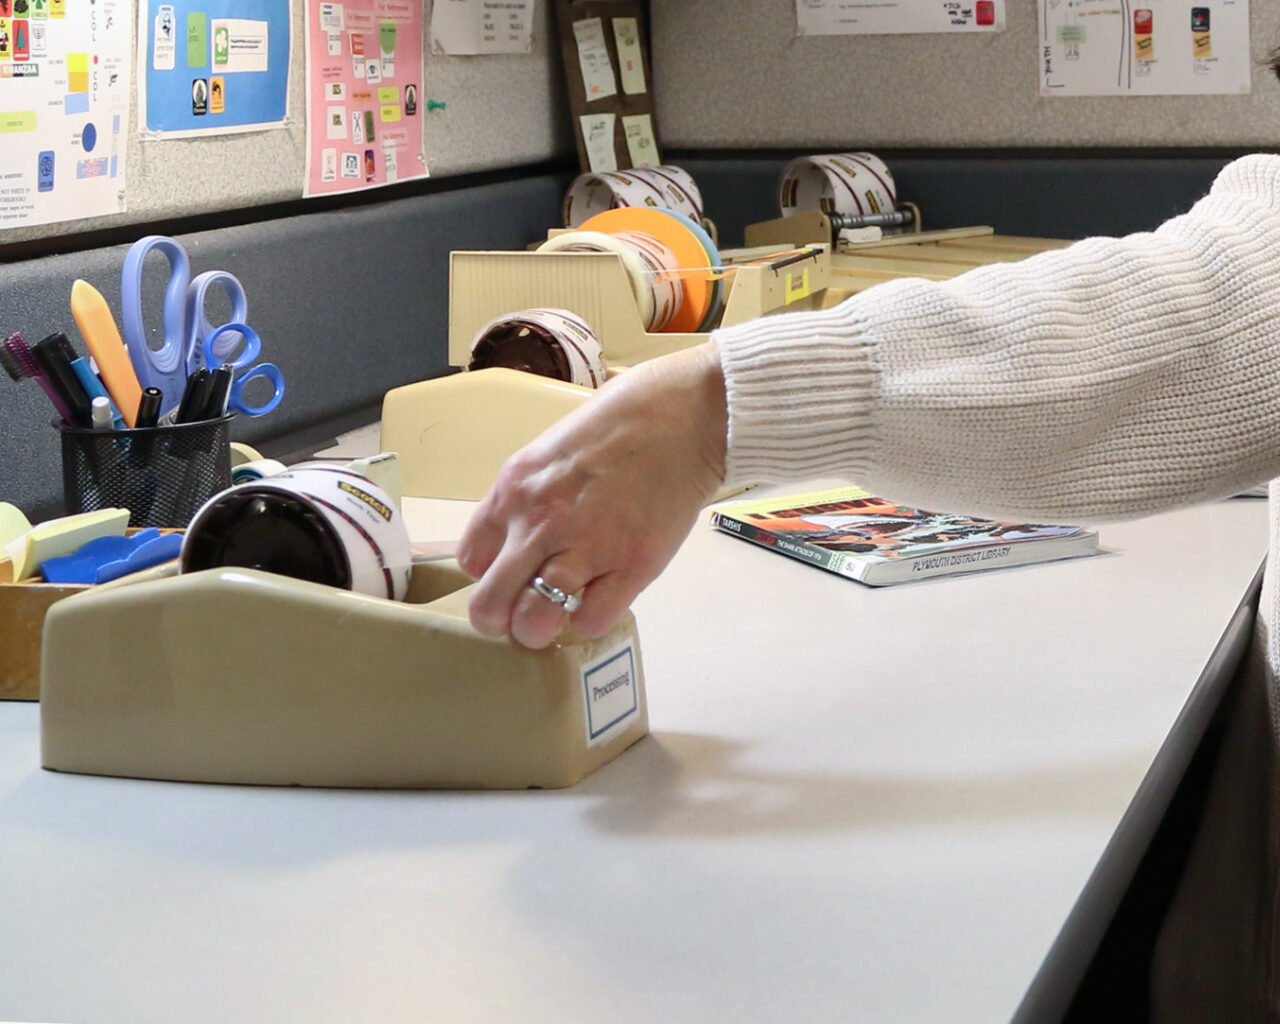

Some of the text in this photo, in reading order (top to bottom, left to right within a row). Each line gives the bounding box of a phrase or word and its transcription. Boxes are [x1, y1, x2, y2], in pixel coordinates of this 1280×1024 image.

[340, 482, 391, 521] Scotch
[912, 546, 1012, 573] PLYMOUTH DISTRICT LIBRARY
[592, 671, 630, 702] Processing
